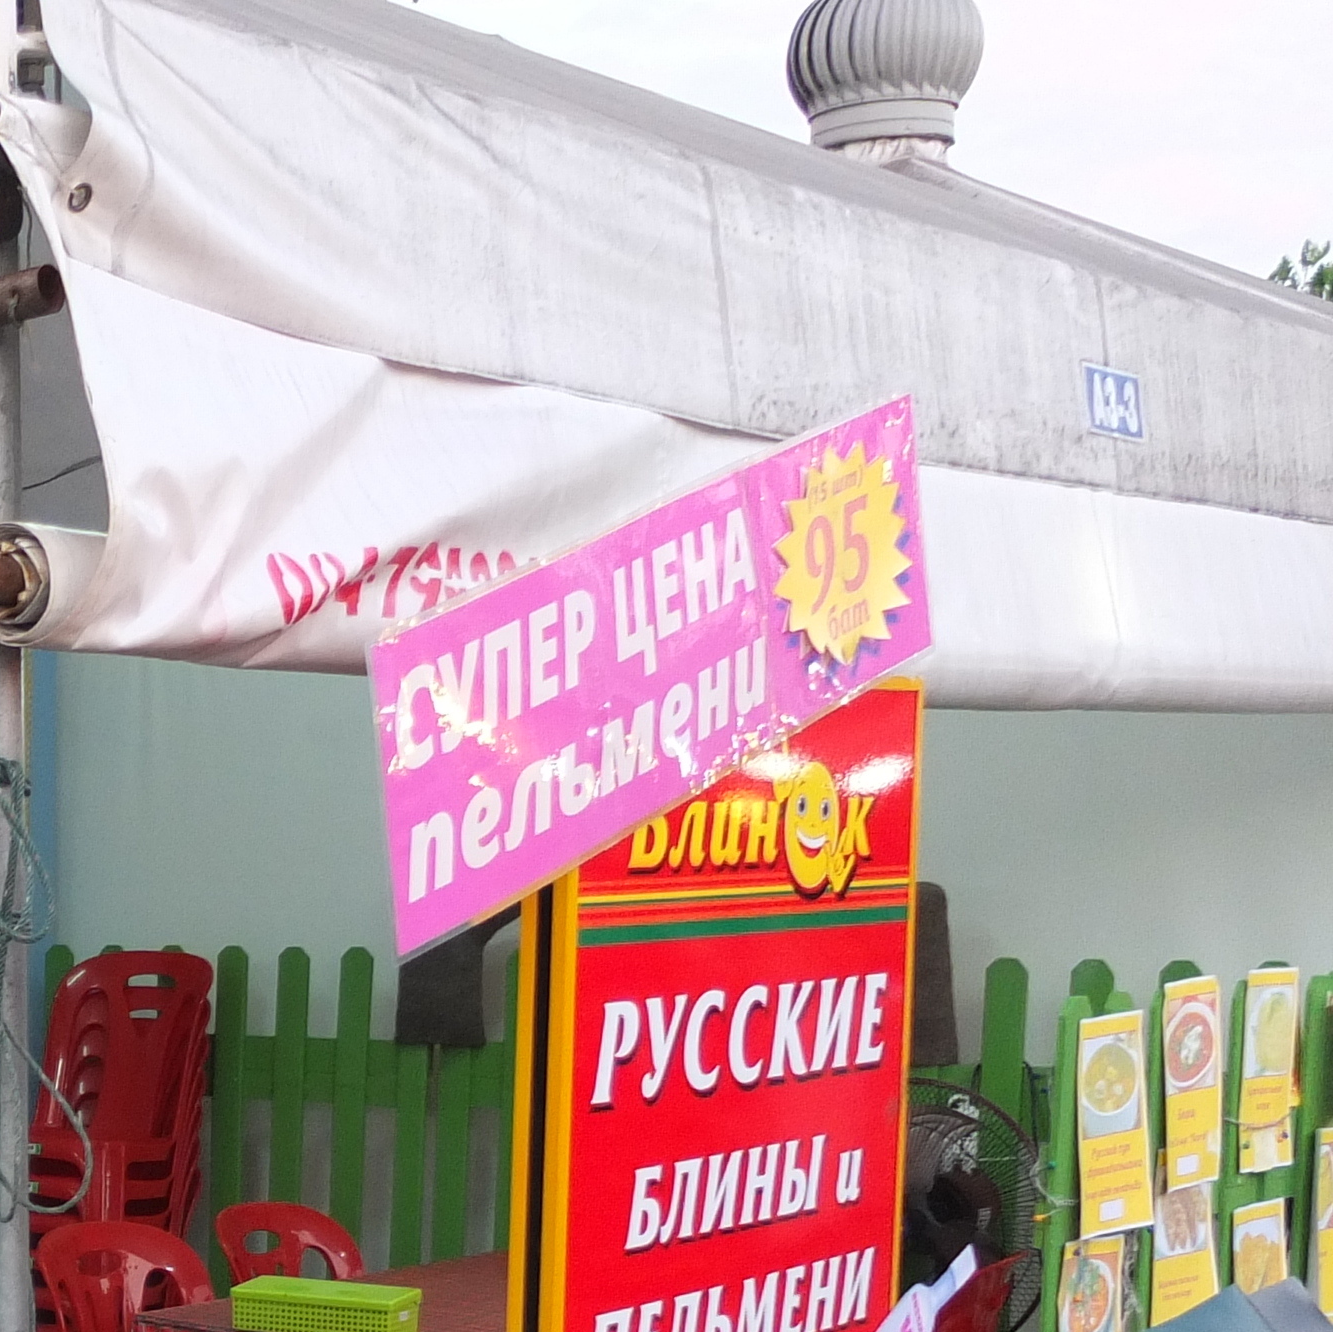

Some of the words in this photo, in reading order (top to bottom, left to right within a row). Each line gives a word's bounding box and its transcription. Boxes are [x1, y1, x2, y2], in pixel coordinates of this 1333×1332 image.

[805, 494, 870, 615] 95
[396, 588, 596, 771] СУПЕР
[613, 508, 757, 677] ЦЕНА
[830, 599, 870, 640] бат
[408, 637, 766, 903] пельмени
[589, 972, 888, 1108] РУССКИЕ
[624, 1134, 827, 1253] БЛИНЫ
[836, 1148, 864, 1206] и
